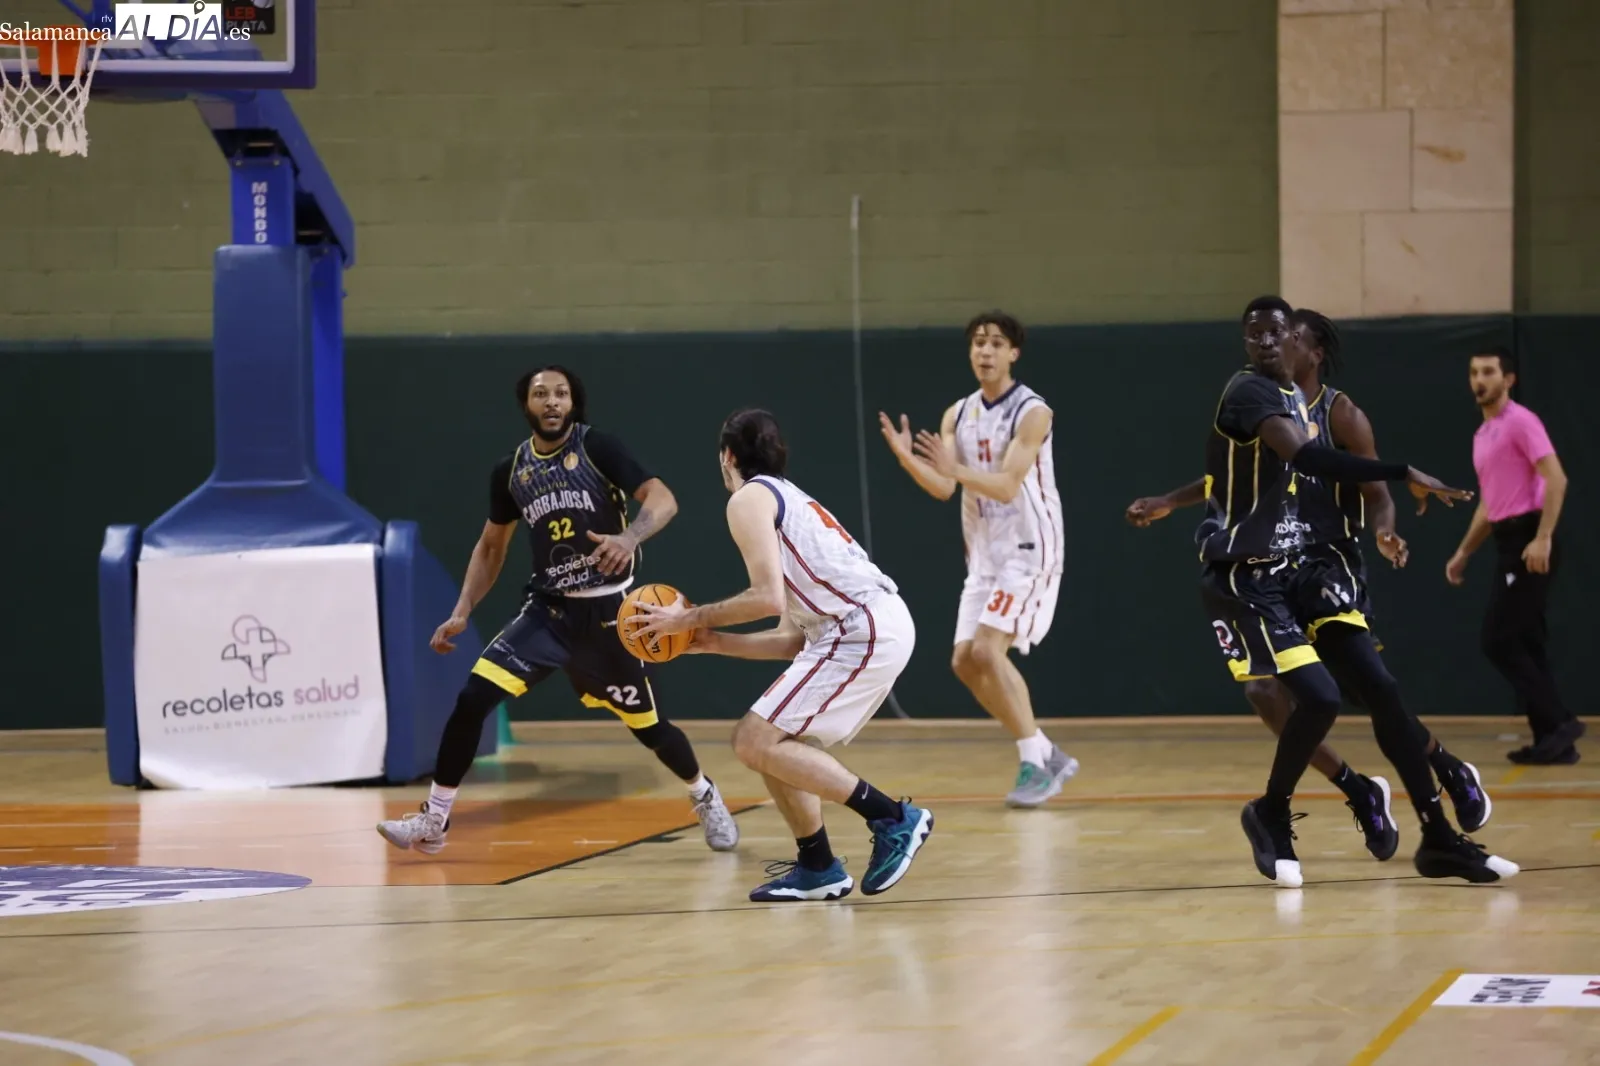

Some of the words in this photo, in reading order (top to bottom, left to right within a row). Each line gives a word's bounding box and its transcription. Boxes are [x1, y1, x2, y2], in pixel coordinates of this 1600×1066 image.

[225, 7, 256, 20] LEB
[252, 181, 268, 244] MONDO
[523, 489, 596, 528] CARBAJOSA
[548, 517, 576, 541] 32
[555, 569, 590, 589] salud
[987, 588, 1014, 617] 31
[161, 686, 285, 719] recoletas
[293, 674, 360, 706] salud
[606, 685, 641, 706] 32
